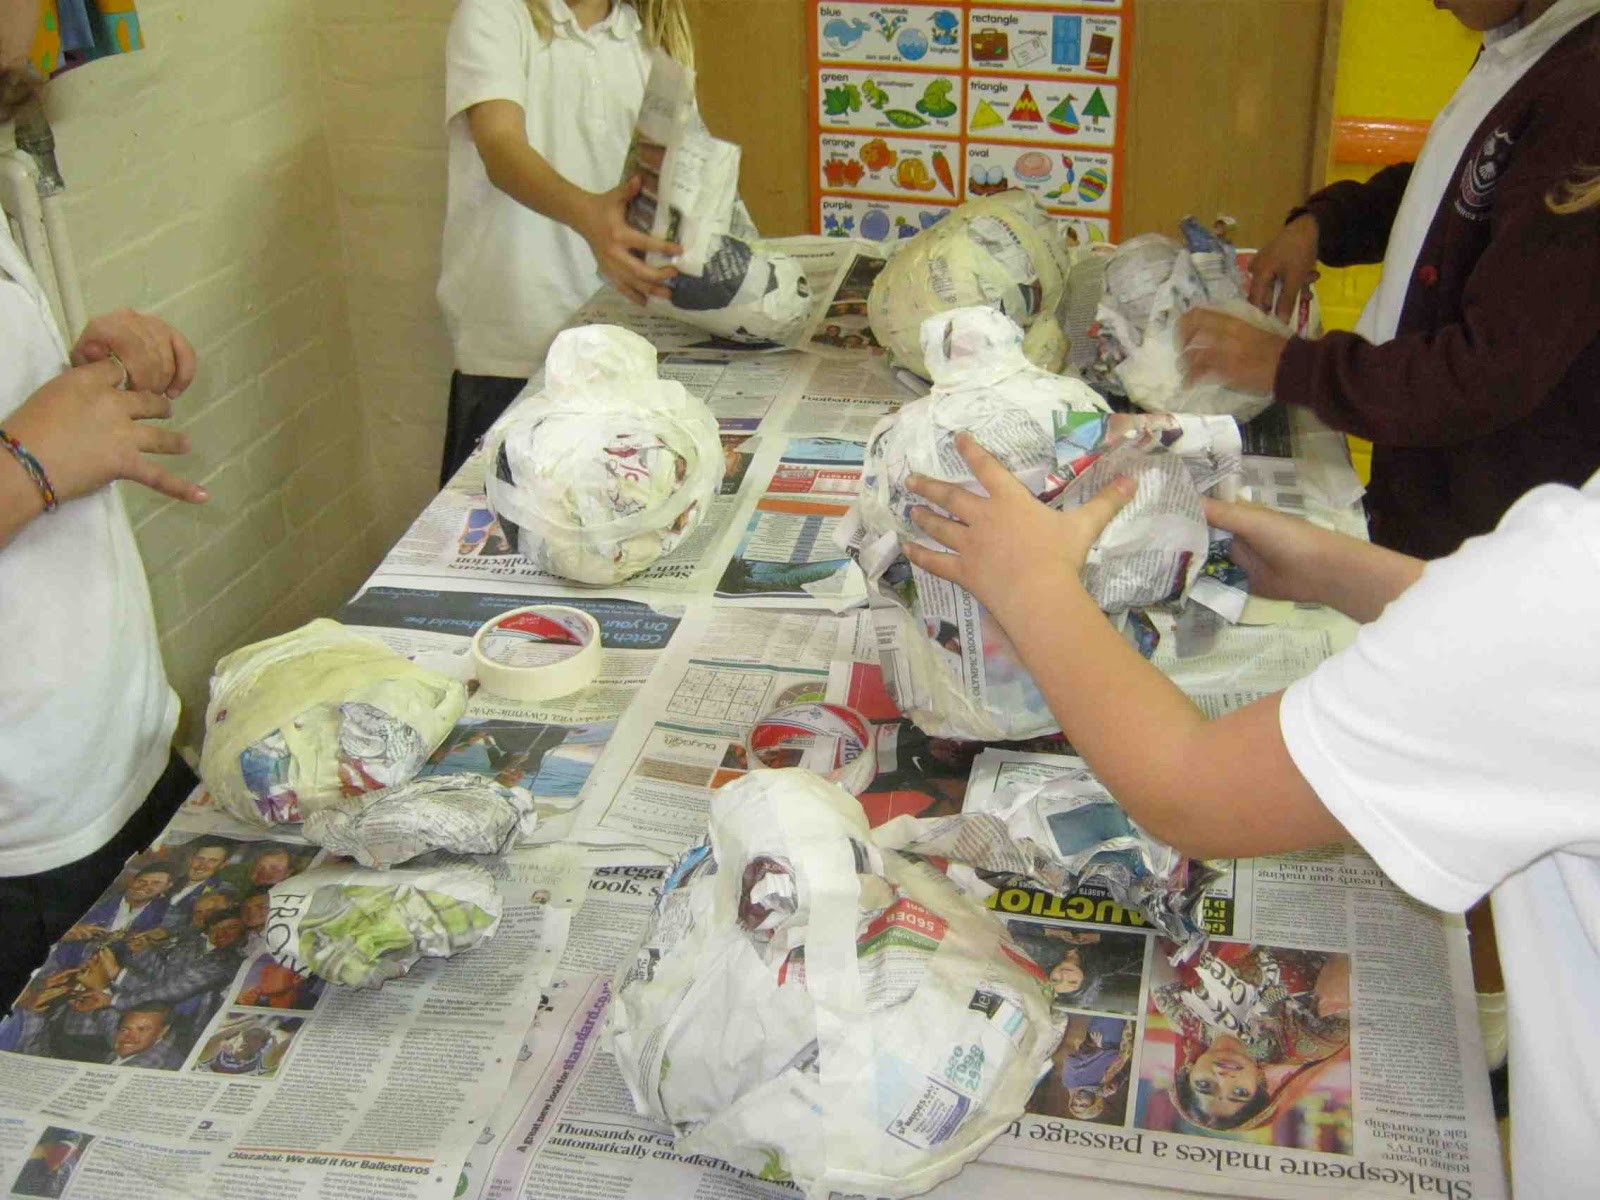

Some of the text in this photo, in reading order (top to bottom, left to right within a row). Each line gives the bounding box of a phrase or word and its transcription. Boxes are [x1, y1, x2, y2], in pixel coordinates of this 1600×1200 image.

[820, 7, 841, 16] blue
[972, 14, 1018, 25] rectangle
[821, 73, 848, 82] green
[970, 81, 1008, 93] triangle
[822, 139, 855, 148] orange
[969, 148, 989, 158] oval
[823, 201, 853, 211] purple
[601, 616, 669, 632] On your
[613, 630, 664, 645] Catch
[967, 656, 981, 697] OLYMPIC
[1279, 863, 1307, 873] died
[1311, 865, 1335, 874] son
[1338, 865, 1358, 876] my
[1257, 870, 1306, 882] making
[1337, 874, 1376, 887] nearly
[986, 888, 1147, 927] AUCTIO
[522, 1121, 544, 1149] great
[536, 1102, 553, 1123] new
[546, 1080, 563, 1103] look
[557, 1069, 571, 1086] for
[904, 1098, 927, 1129] BRIDES
[922, 1083, 937, 1100] BAY
[1364, 1117, 1426, 1135] courtship
[556, 1122, 636, 1143] Thousands
[637, 1132, 651, 1146] of
[1029, 1122, 1144, 1154] passage
[1373, 1130, 1422, 1144] modern
[1443, 1129, 1467, 1139] tale
[548, 1136, 650, 1160] automatically
[1152, 1141, 1170, 1154] a
[1418, 1147, 1442, 1157] and
[1442, 1140, 1469, 1152] Syal
[228, 1151, 283, 1163] Olazabal:
[285, 1154, 305, 1165] We
[307, 1155, 329, 1167] did
[339, 1158, 359, 1169] for
[360, 1160, 431, 1176] Ballesteros
[1177, 1144, 1273, 1174] makes
[1381, 1153, 1470, 1173] Rising theatre
[1445, 1152, 1470, 1162] star
[1281, 1158, 1473, 1200] Shakespeare
